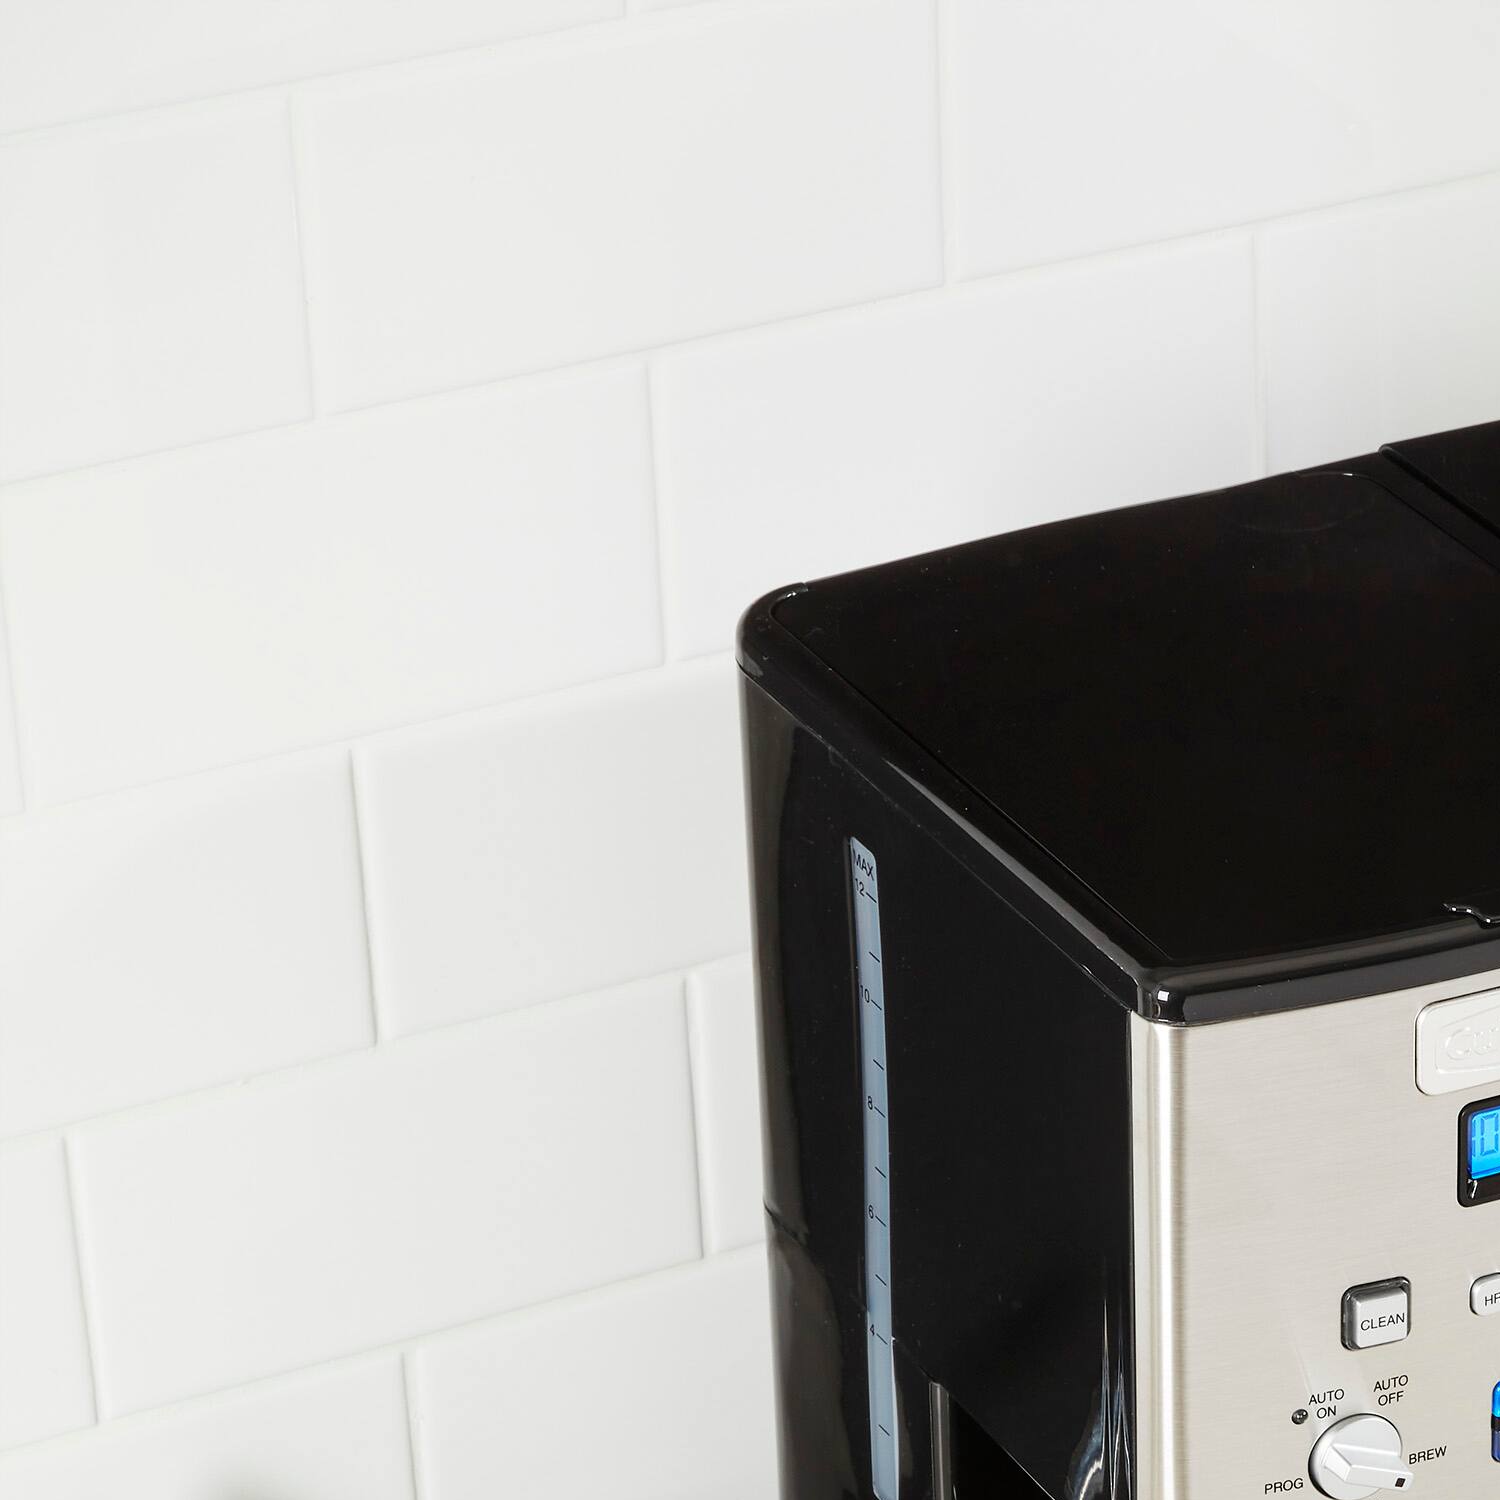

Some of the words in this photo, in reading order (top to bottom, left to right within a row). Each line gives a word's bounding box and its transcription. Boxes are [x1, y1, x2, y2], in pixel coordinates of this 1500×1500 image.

[853, 848, 875, 882] MAX
[855, 878, 865, 897] 12
[859, 984, 870, 1003] 10
[867, 1095, 873, 1111] 8
[868, 1204, 874, 1219] 6
[869, 1323, 875, 1336] 4
[1360, 1312, 1405, 1331] CLEAN
[1373, 1374, 1409, 1393] AUTO
[1308, 1388, 1345, 1406] AUTO
[1377, 1390, 1404, 1407] OFF
[1316, 1405, 1337, 1419] ON
[1408, 1445, 1447, 1465] BREW
[1264, 1477, 1304, 1495] PROG
